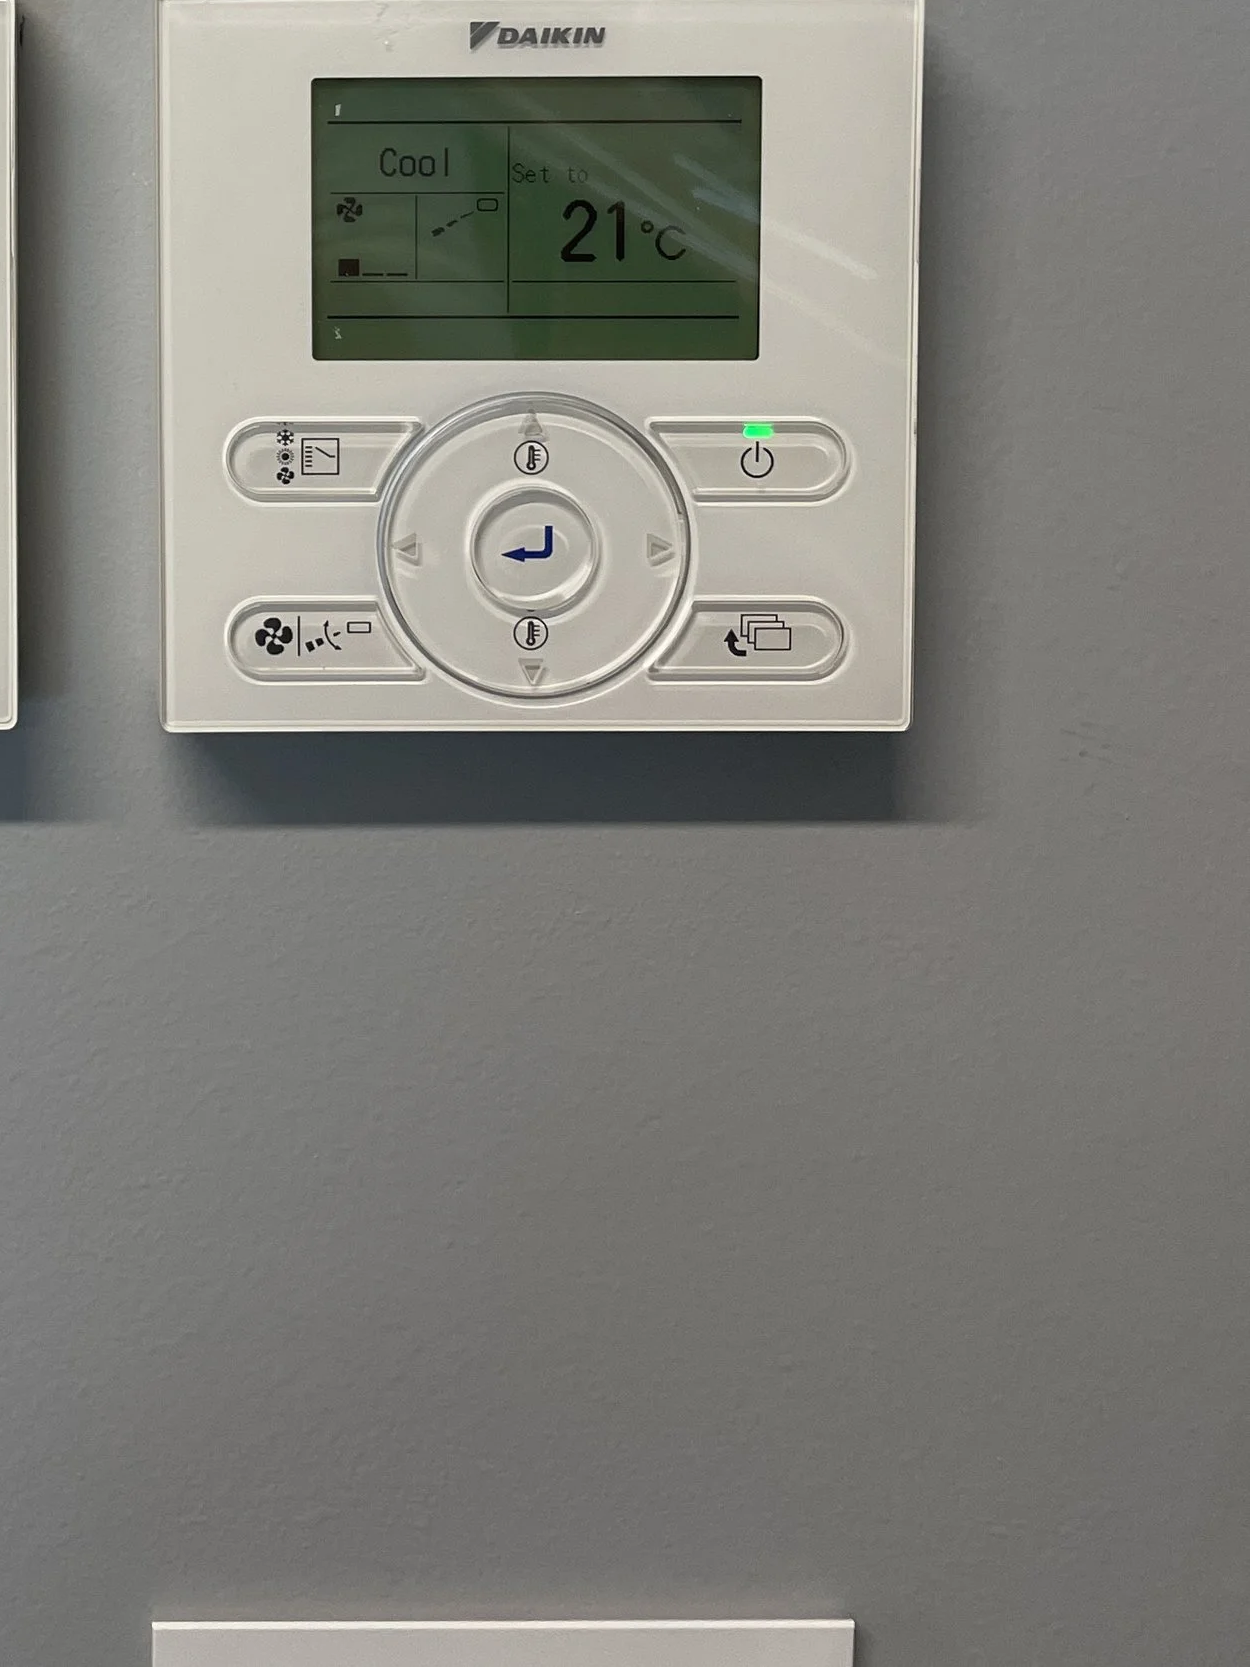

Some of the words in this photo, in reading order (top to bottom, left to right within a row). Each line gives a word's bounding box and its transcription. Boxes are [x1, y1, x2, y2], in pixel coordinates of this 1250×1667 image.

[496, 26, 606, 48] DAIKIN
[379, 148, 450, 178] Cool
[512, 164, 549, 183] Set
[568, 165, 589, 183] to
